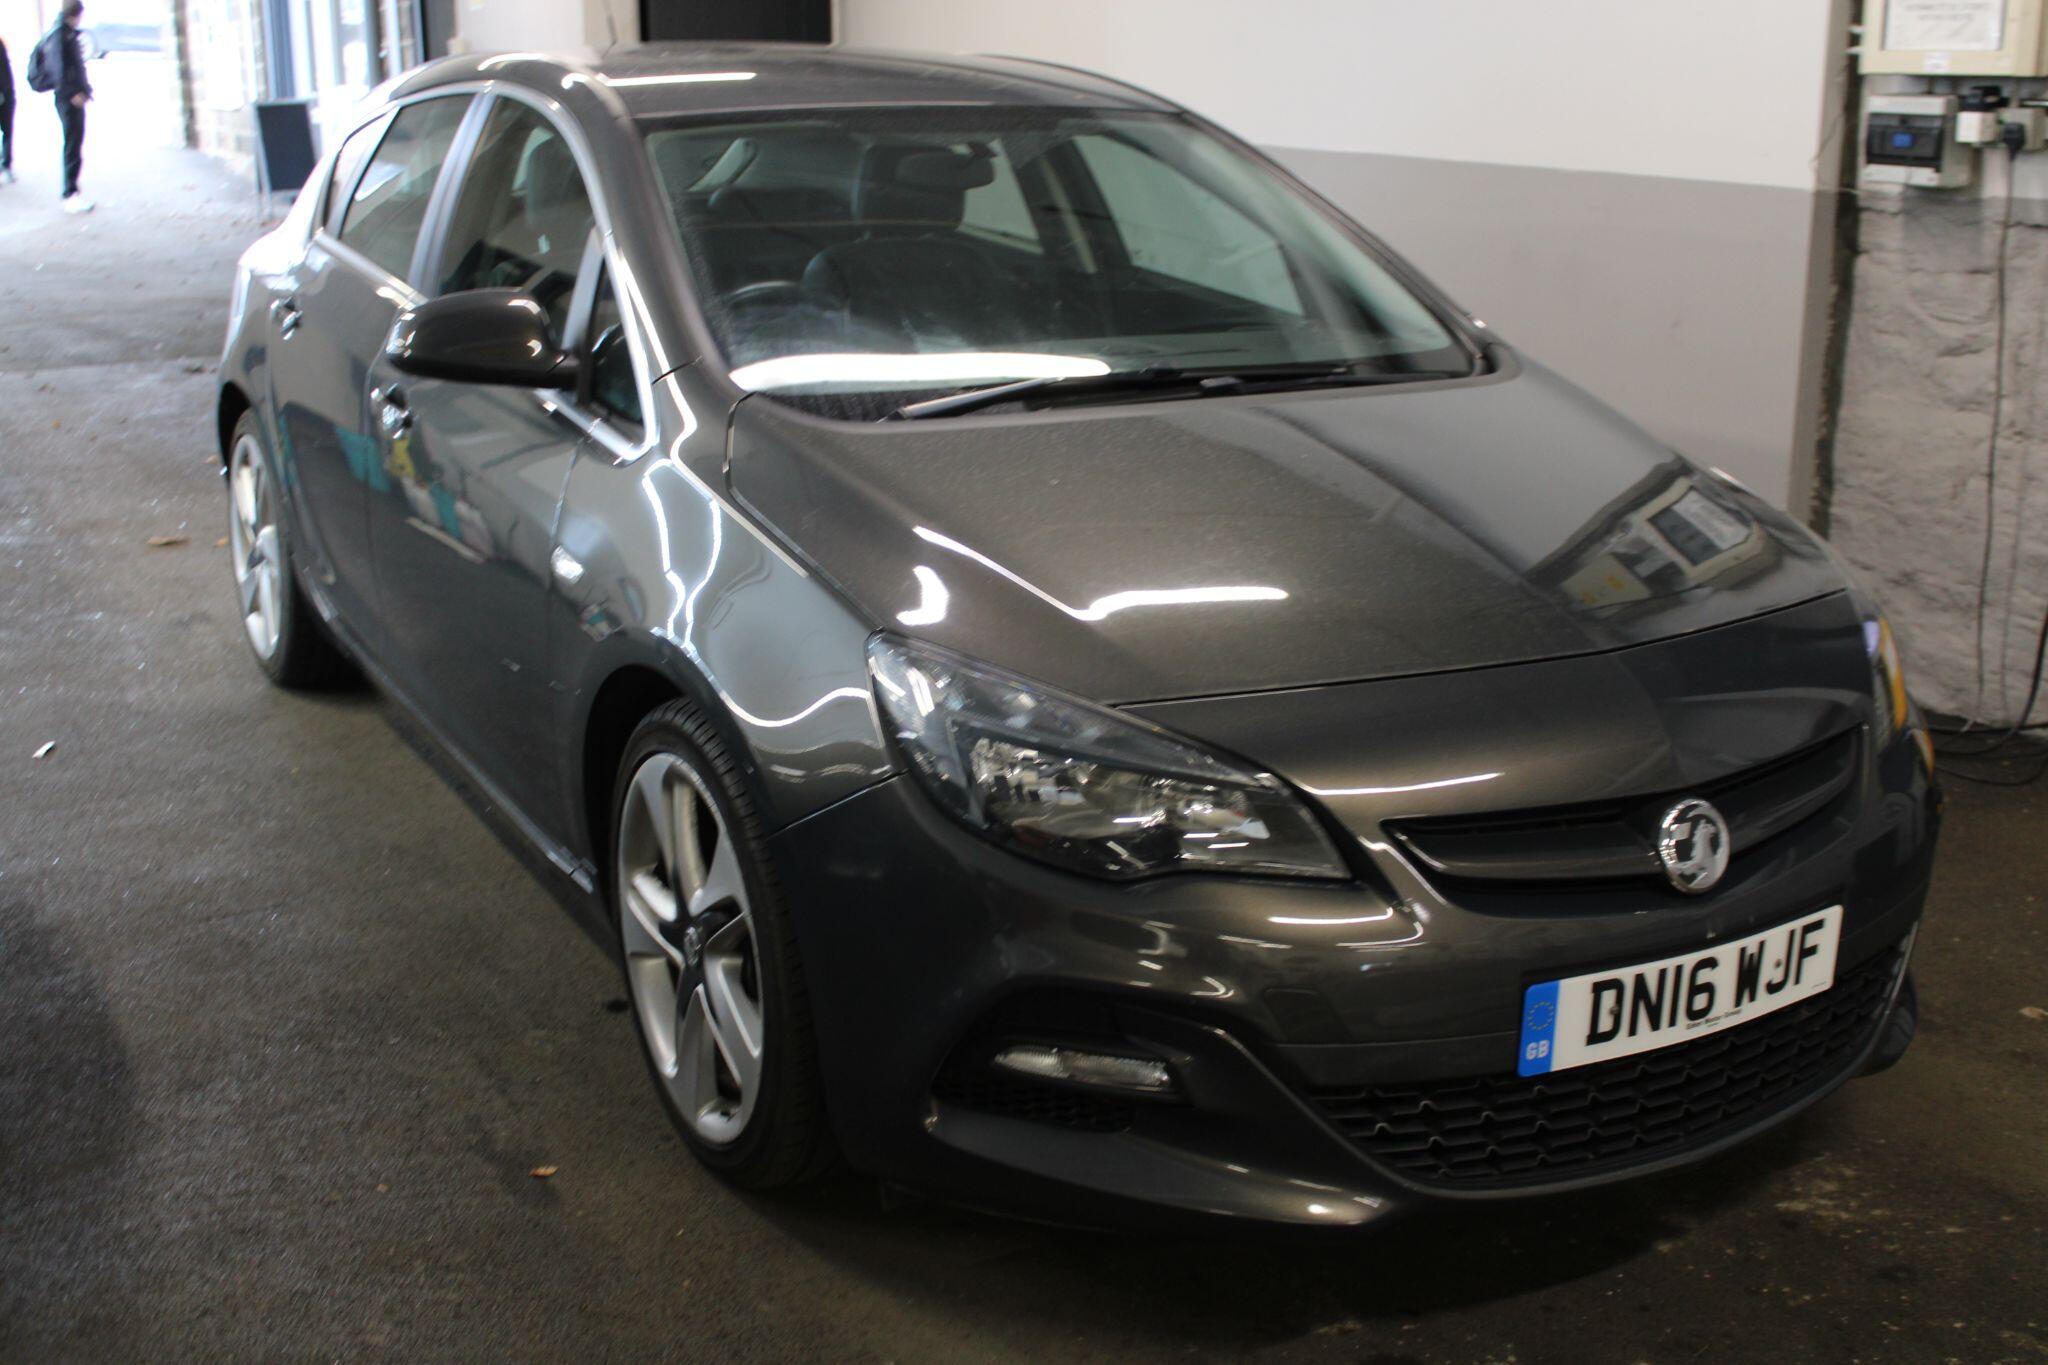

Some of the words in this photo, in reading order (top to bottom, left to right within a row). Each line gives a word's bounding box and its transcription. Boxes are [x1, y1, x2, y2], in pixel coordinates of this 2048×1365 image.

[1586, 956, 1719, 1046] DN16
[1734, 918, 1825, 1009] WJF
[1526, 1040, 1550, 1060] GB
